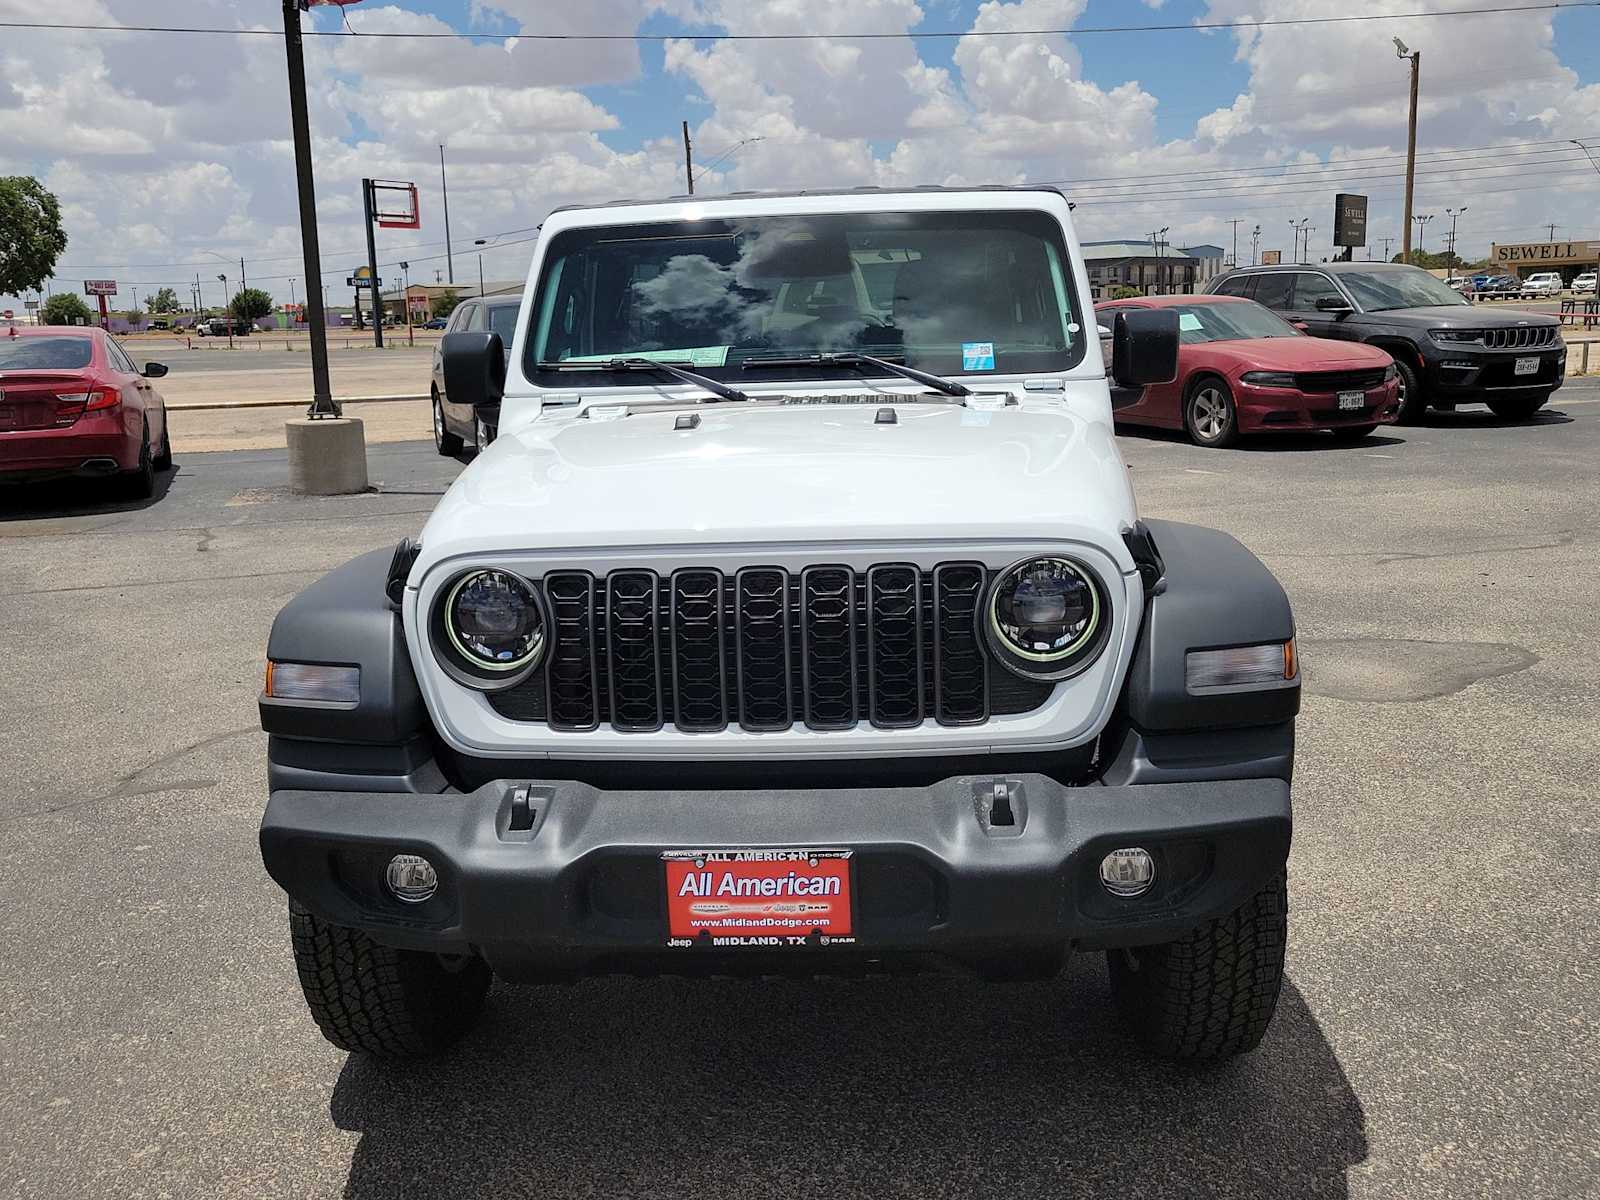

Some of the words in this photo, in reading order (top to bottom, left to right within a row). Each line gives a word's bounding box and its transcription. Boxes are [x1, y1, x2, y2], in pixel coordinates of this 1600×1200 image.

[1499, 244, 1577, 261] SEWELL
[706, 852, 731, 862] ALL
[735, 850, 808, 861] AMERICN
[679, 872, 713, 897] All
[716, 871, 841, 897] American
[691, 918, 830, 928] www.MidlandDodge.com
[667, 937, 692, 948] Jeep
[713, 936, 783, 946] MIDLAND,
[786, 936, 806, 945] TX
